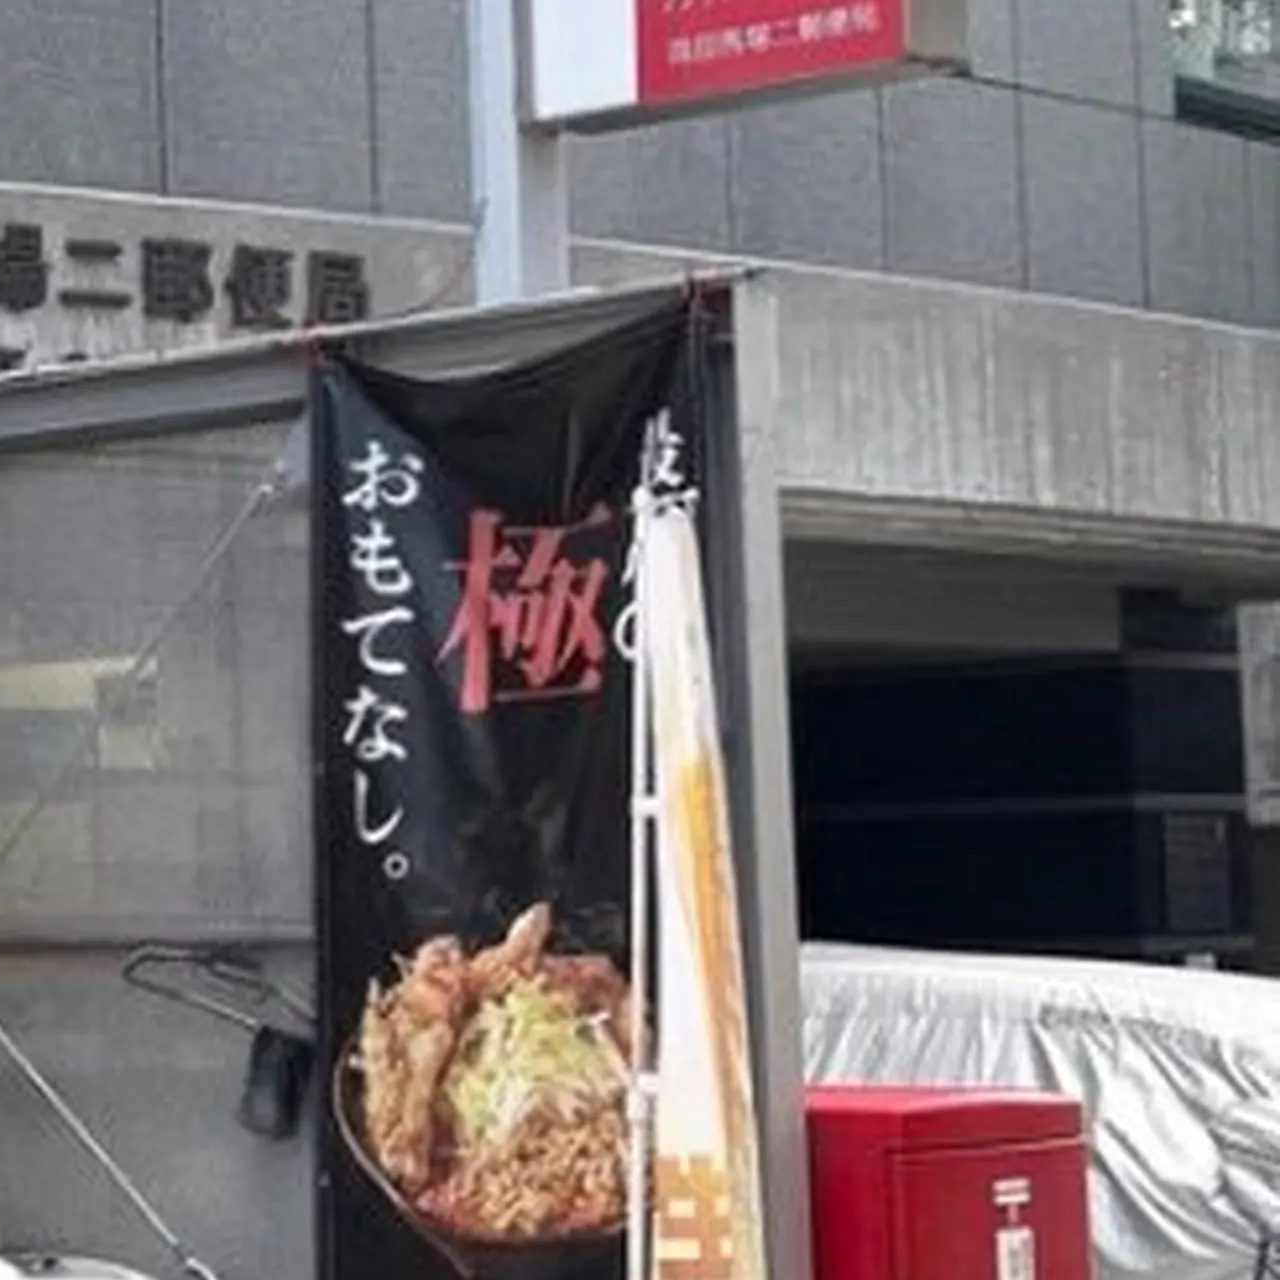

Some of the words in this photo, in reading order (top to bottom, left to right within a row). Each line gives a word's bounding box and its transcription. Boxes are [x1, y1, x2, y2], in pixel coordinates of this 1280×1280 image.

[342, 440, 427, 880] おもてなし。
[434, 500, 617, 714] 極
